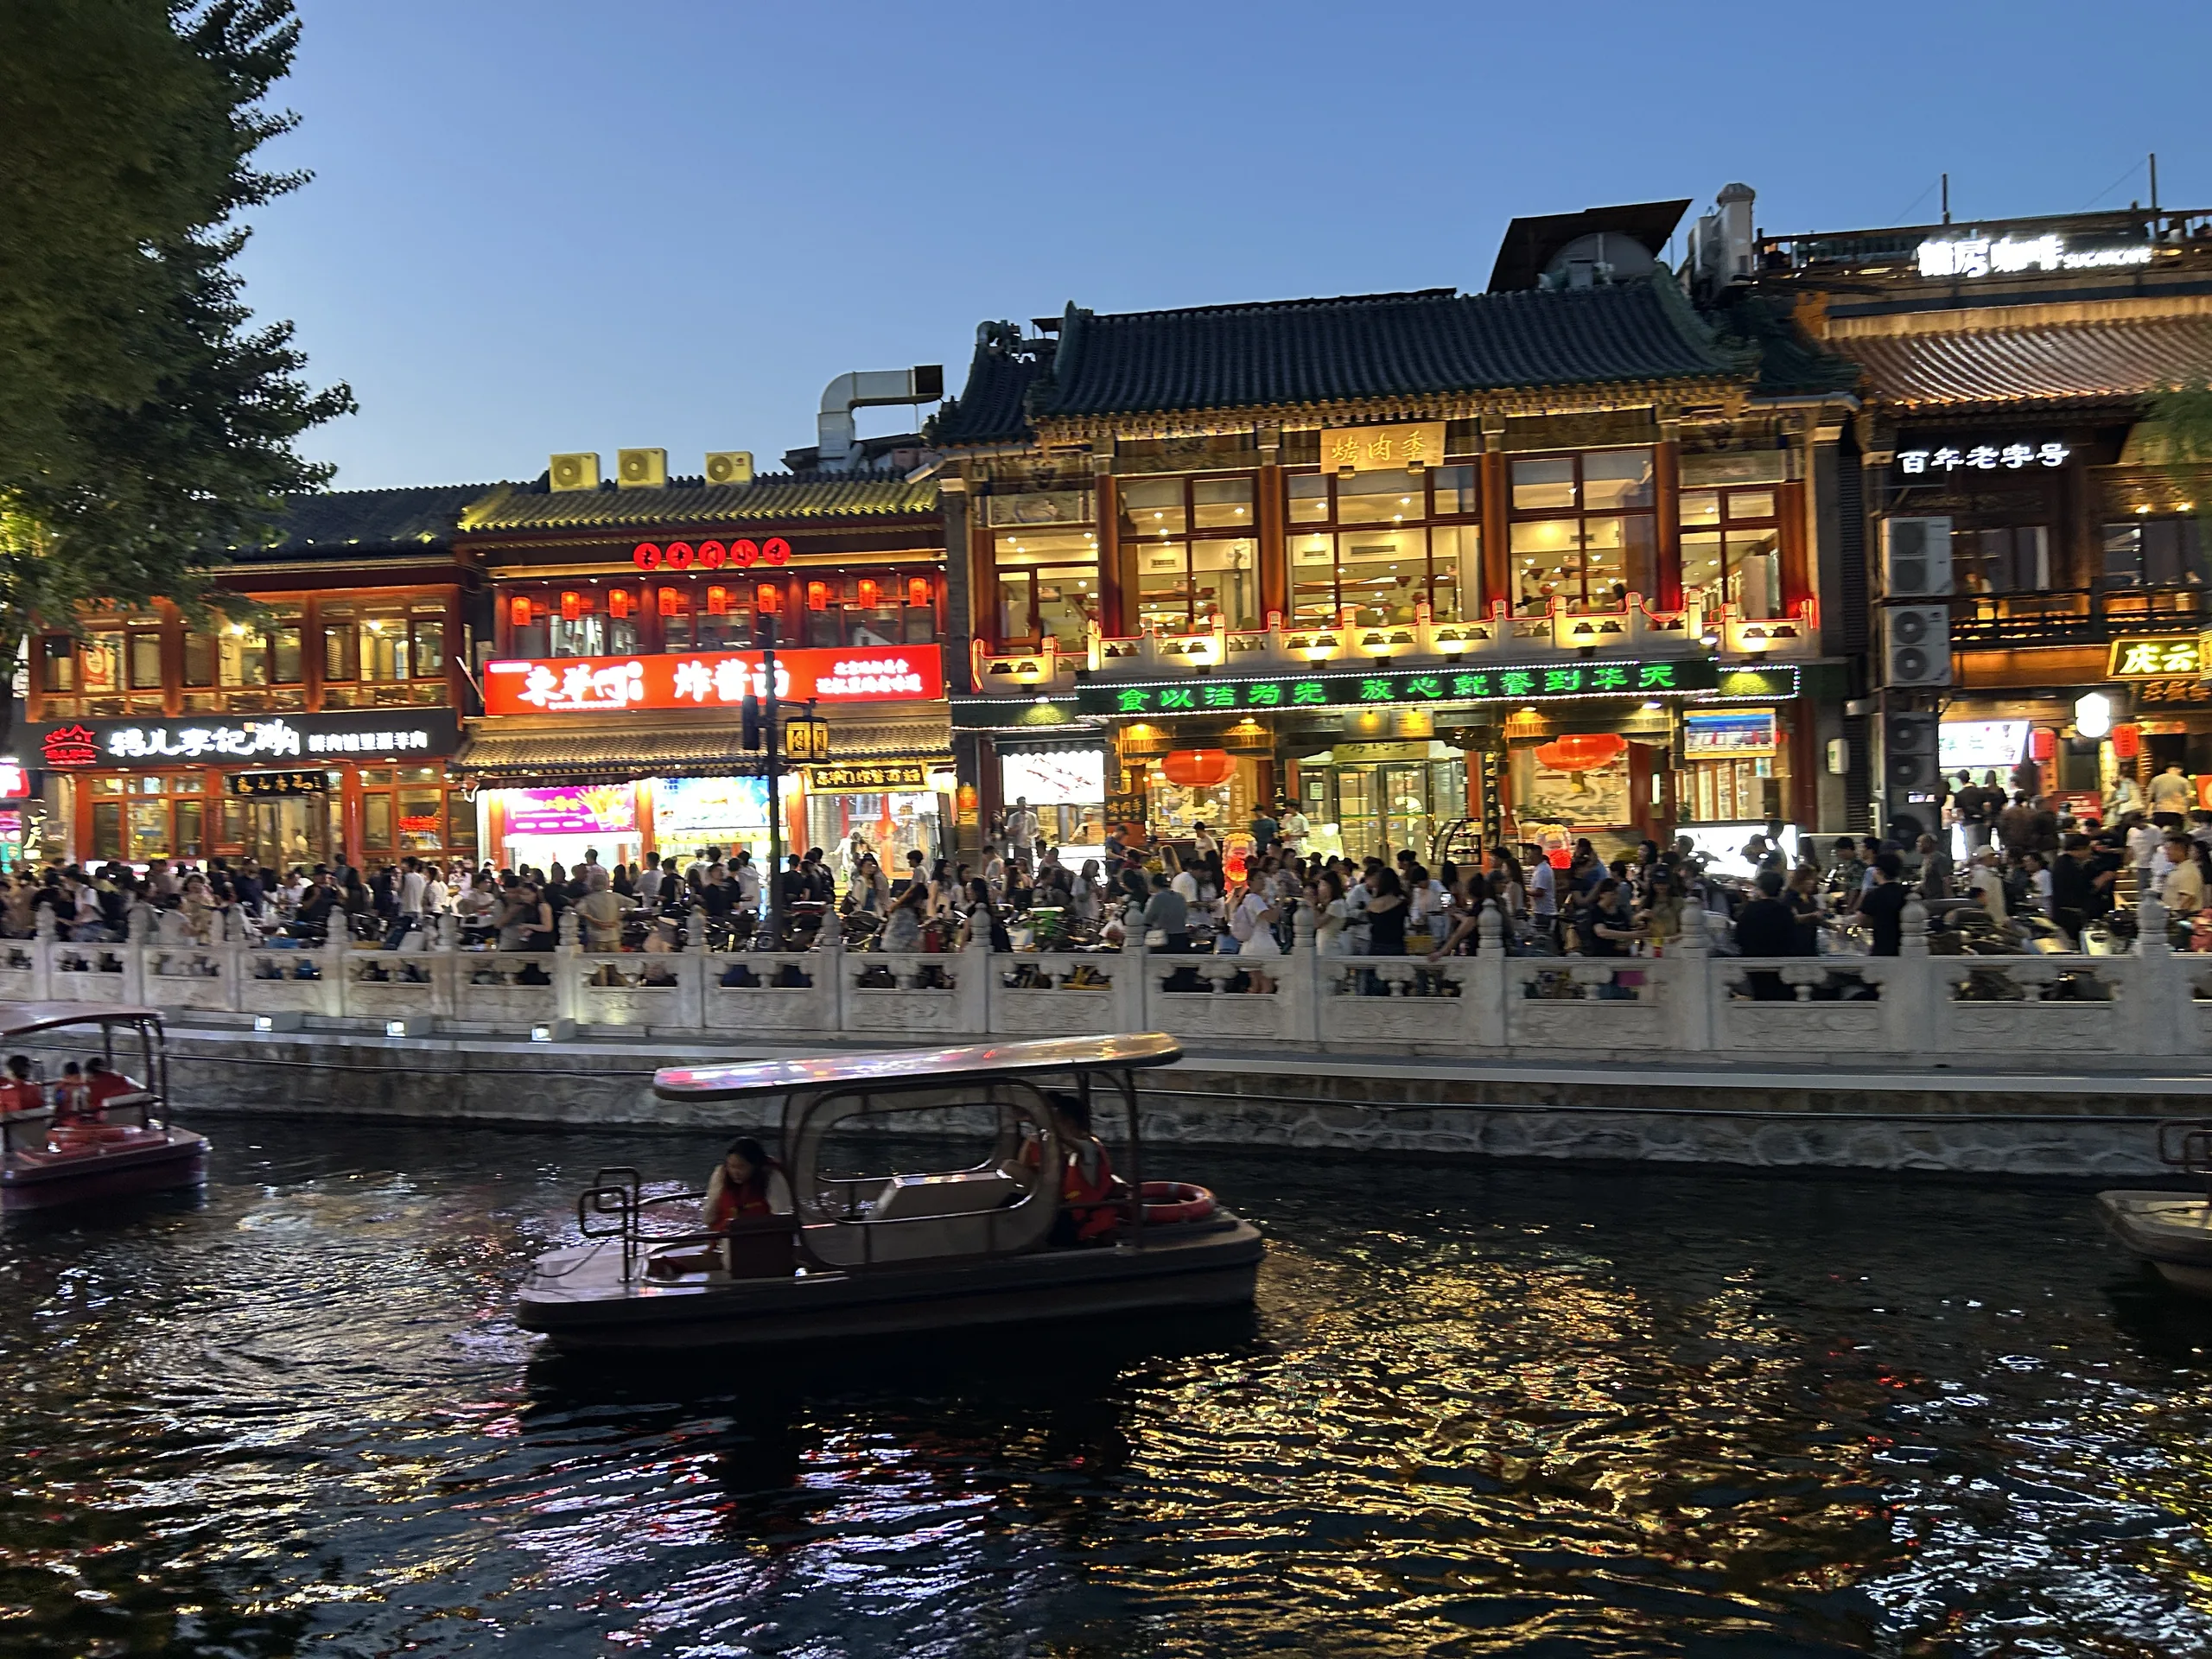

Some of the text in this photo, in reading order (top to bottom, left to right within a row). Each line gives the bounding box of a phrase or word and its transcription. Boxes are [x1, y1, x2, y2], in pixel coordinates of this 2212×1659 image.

[1331, 430, 1427, 464] 烤肉季
[1897, 443, 2070, 474] 百年老字号
[2120, 644, 2202, 674] 庆云
[1116, 665, 1676, 711] 食以洁为先 放心就餐到华天
